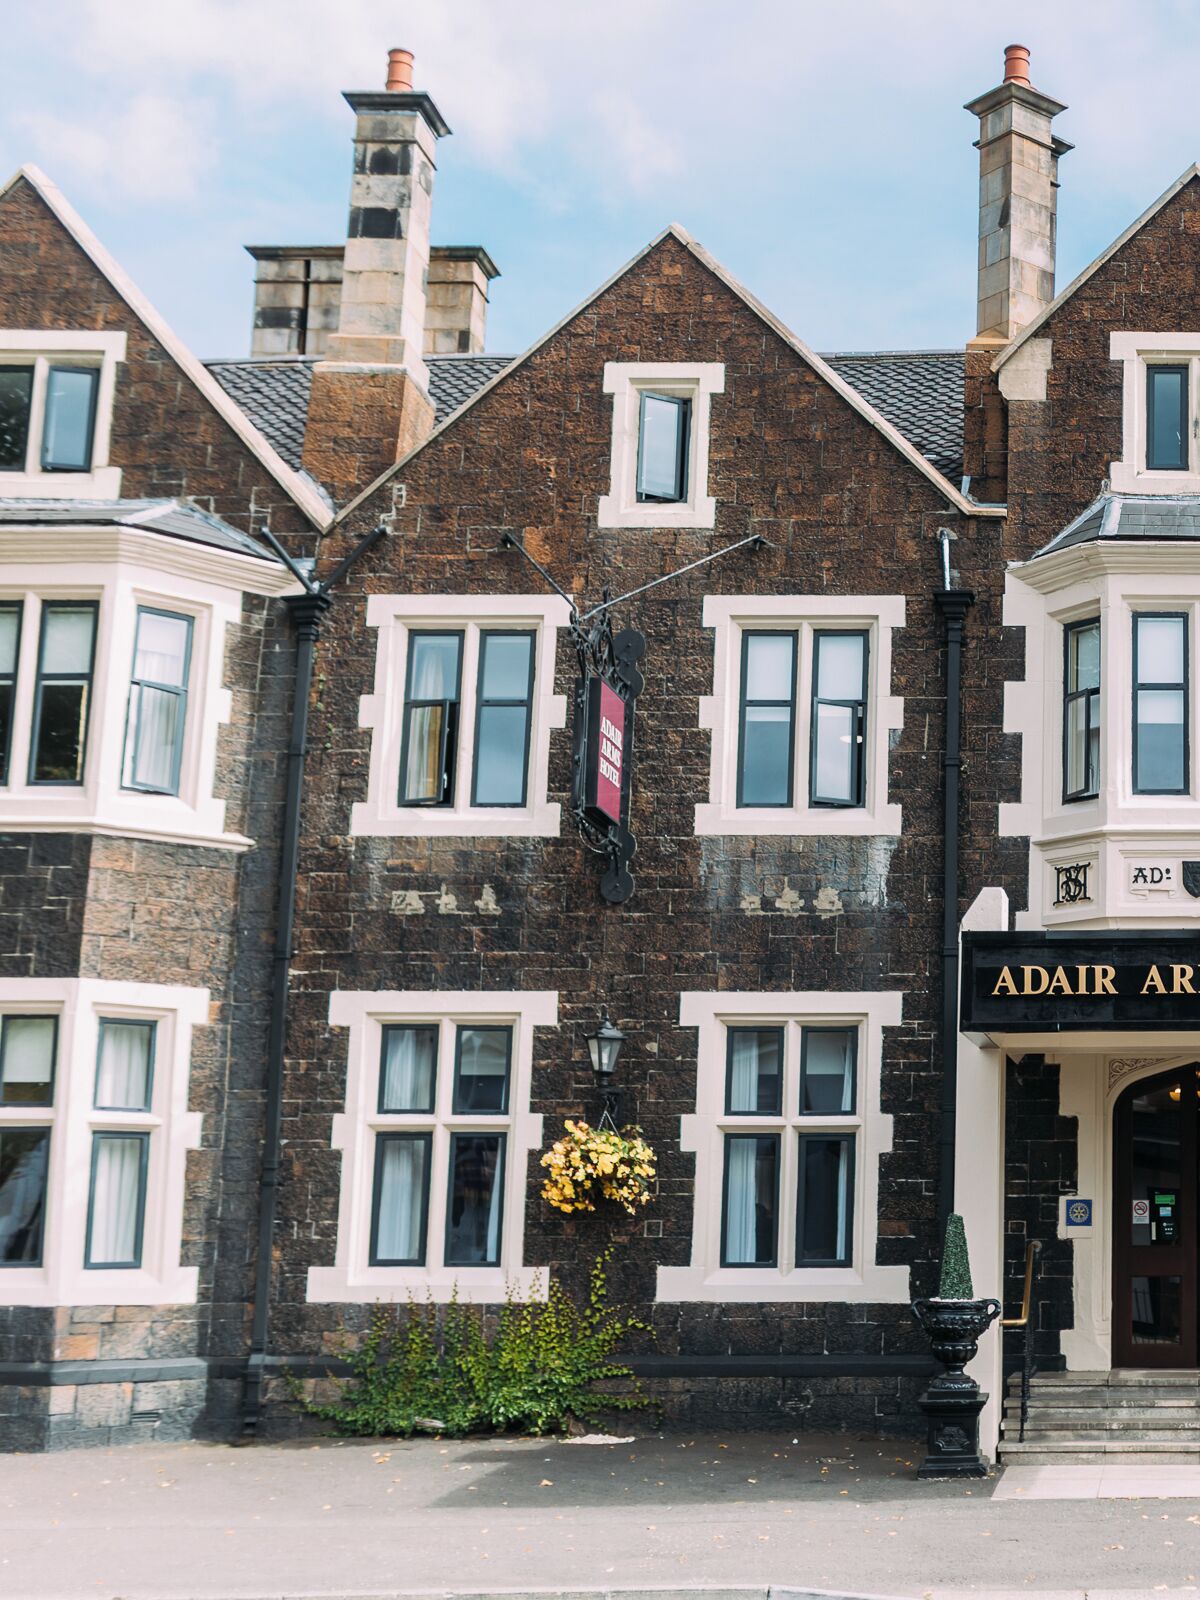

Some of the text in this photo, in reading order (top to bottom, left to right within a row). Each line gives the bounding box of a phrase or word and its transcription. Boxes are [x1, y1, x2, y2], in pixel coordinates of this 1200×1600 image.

[600, 716, 623, 751] ADAIR
[600, 737, 621, 768] ARMS
[599, 756, 620, 788] HOTEL
[991, 965, 1119, 996] ADAIR
